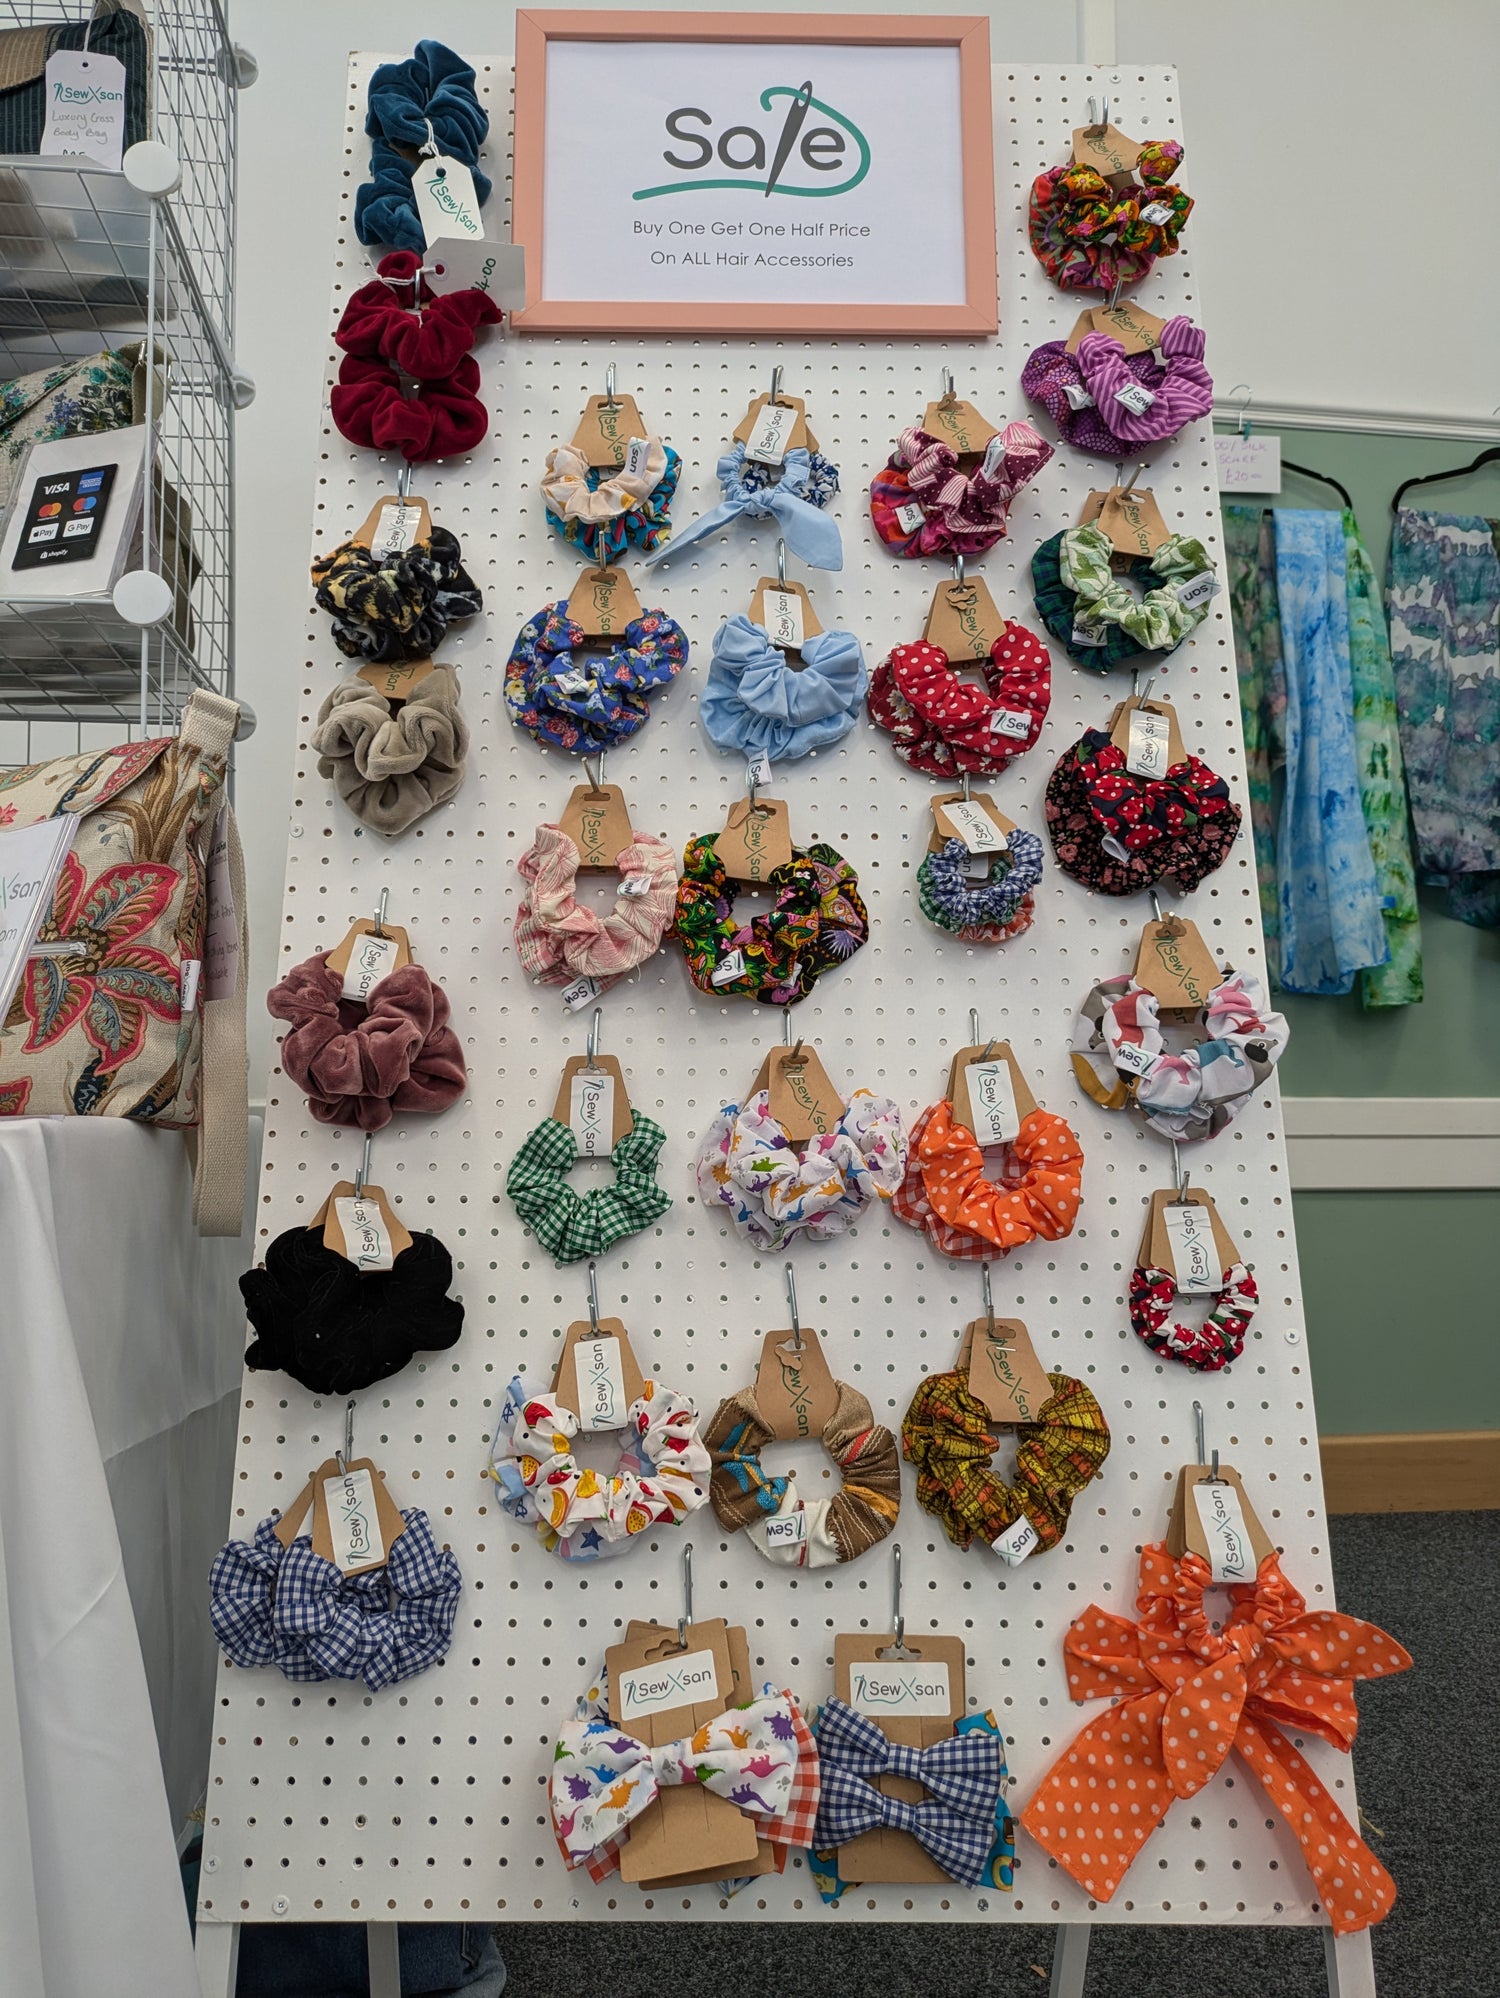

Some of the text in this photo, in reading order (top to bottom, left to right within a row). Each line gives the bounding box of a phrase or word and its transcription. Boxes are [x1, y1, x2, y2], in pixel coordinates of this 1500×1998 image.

[52, 110, 88, 129] Luxury
[53, 127, 108, 145] Body Bag
[663, 81, 846, 198] Sale
[633, 220, 871, 237] Buy One Get One Half Price
[650, 250, 854, 267] On ALL Hair Accessories
[44, 482, 70, 495] VISA
[39, 528, 55, 537] Pay
[76, 522, 89, 532] Pay
[48, 548, 69, 558] shopify
[564, 985, 588, 1004] Sew
[1118, 1048, 1143, 1067] Sew
[789, 1369, 813, 1437] ewXsan
[766, 1522, 793, 1536] Sew
